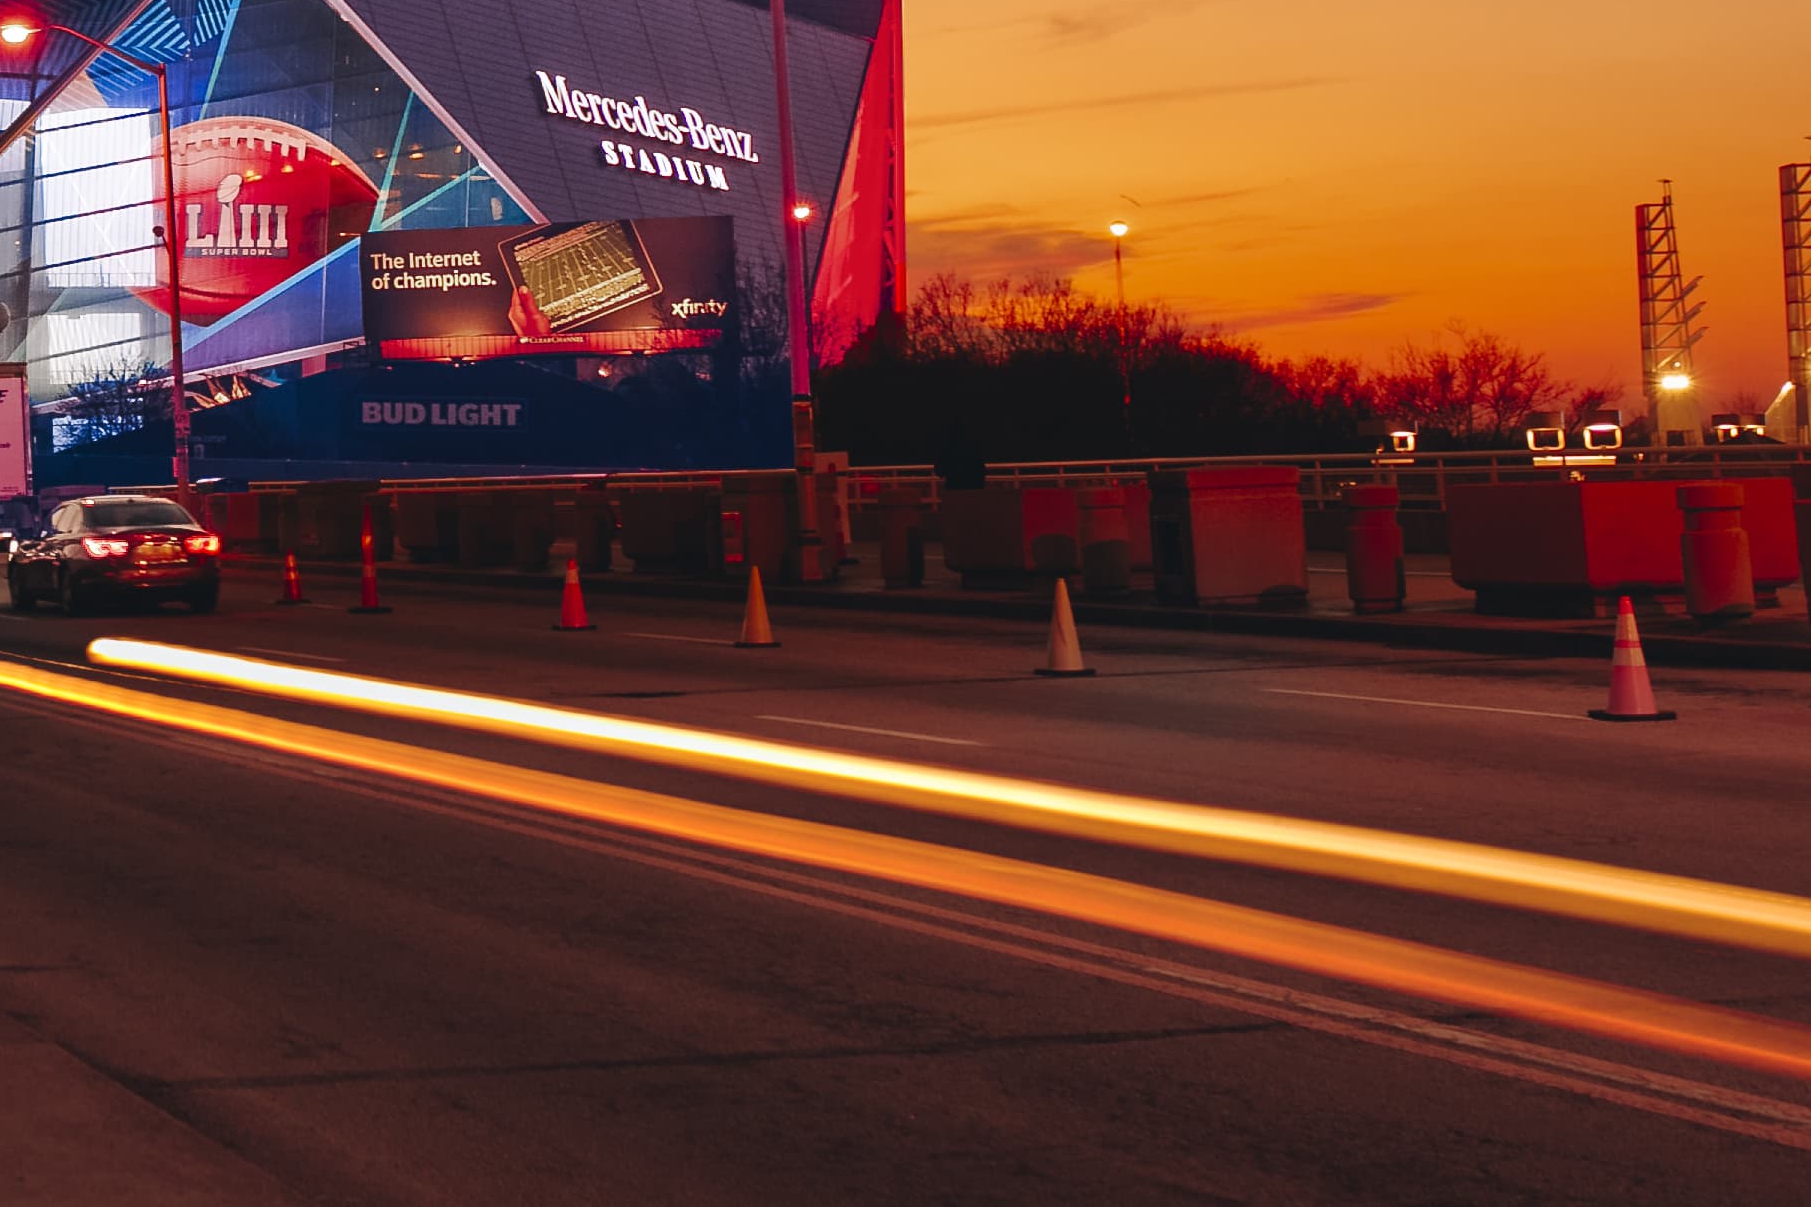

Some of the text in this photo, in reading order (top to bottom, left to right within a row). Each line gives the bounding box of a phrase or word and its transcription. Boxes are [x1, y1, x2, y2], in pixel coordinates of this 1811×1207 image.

[535, 70, 760, 163] Mercedes-Benz
[600, 140, 731, 191] STADIUM
[201, 248, 273, 256] SUPER BOWL
[370, 250, 482, 270] The Internet
[371, 269, 497, 292] of champions.
[361, 401, 522, 426] BUD LIGHT
